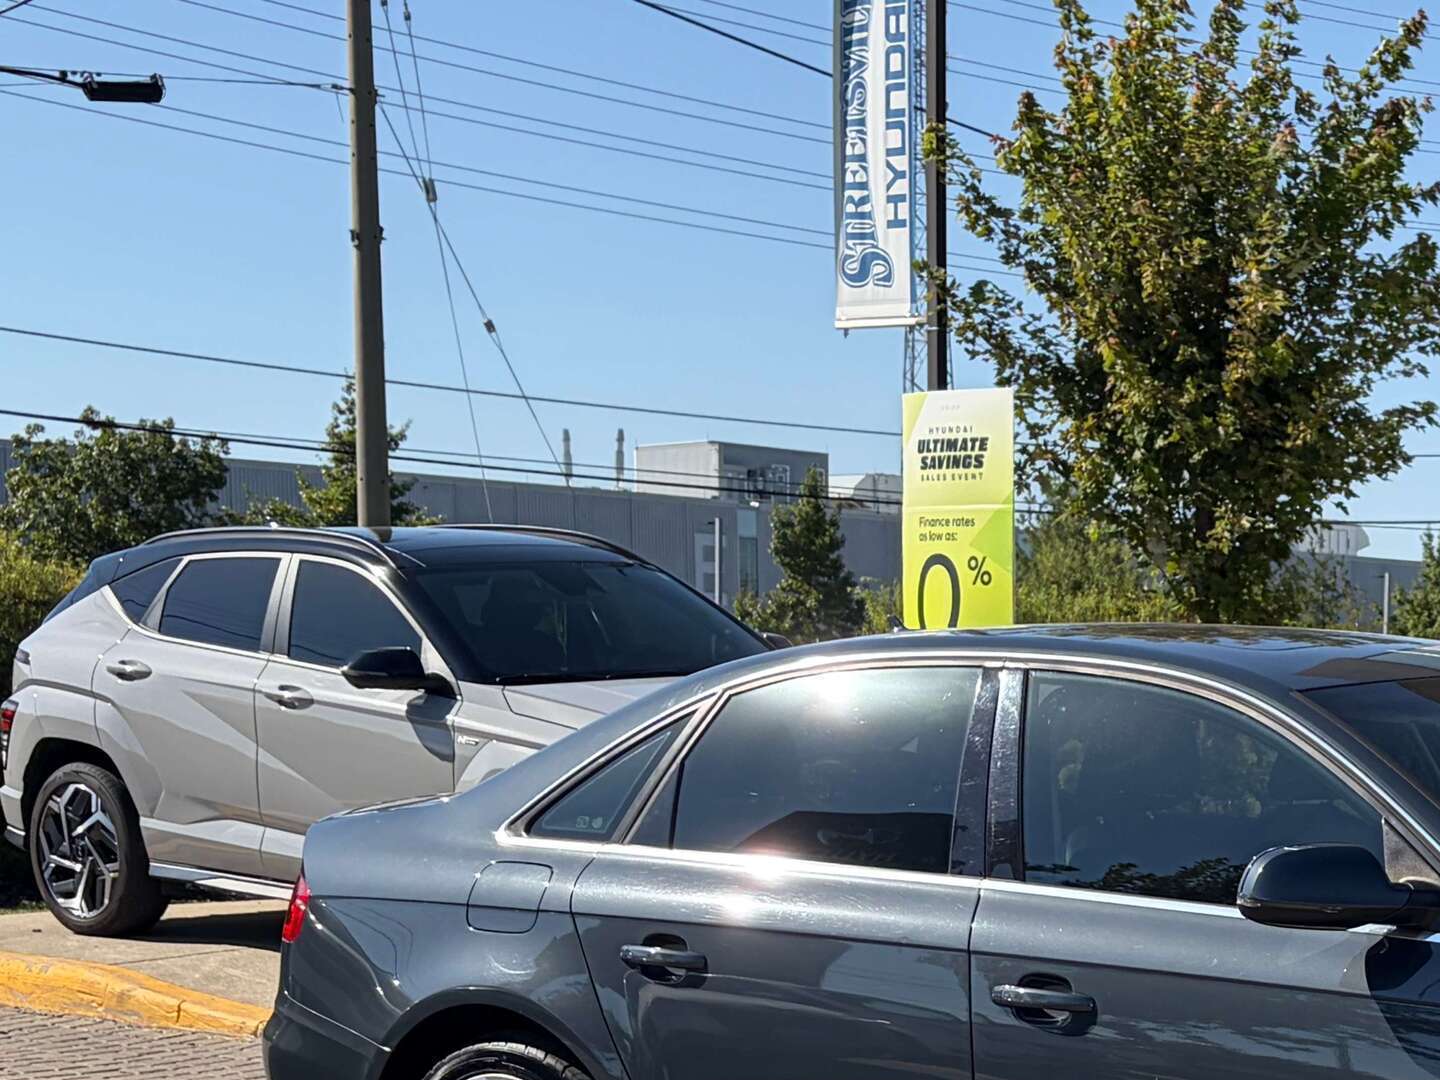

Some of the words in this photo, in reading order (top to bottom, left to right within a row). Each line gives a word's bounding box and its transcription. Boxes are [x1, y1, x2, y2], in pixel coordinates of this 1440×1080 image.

[917, 436, 990, 454] ULTIMATE
[920, 453, 985, 470] SAVINGS
[921, 473, 947, 482] SALES
[951, 471, 983, 481] EVENT
[919, 516, 951, 527] Finance
[952, 516, 975, 527] rates
[918, 532, 927, 541] as
[928, 530, 943, 541] low
